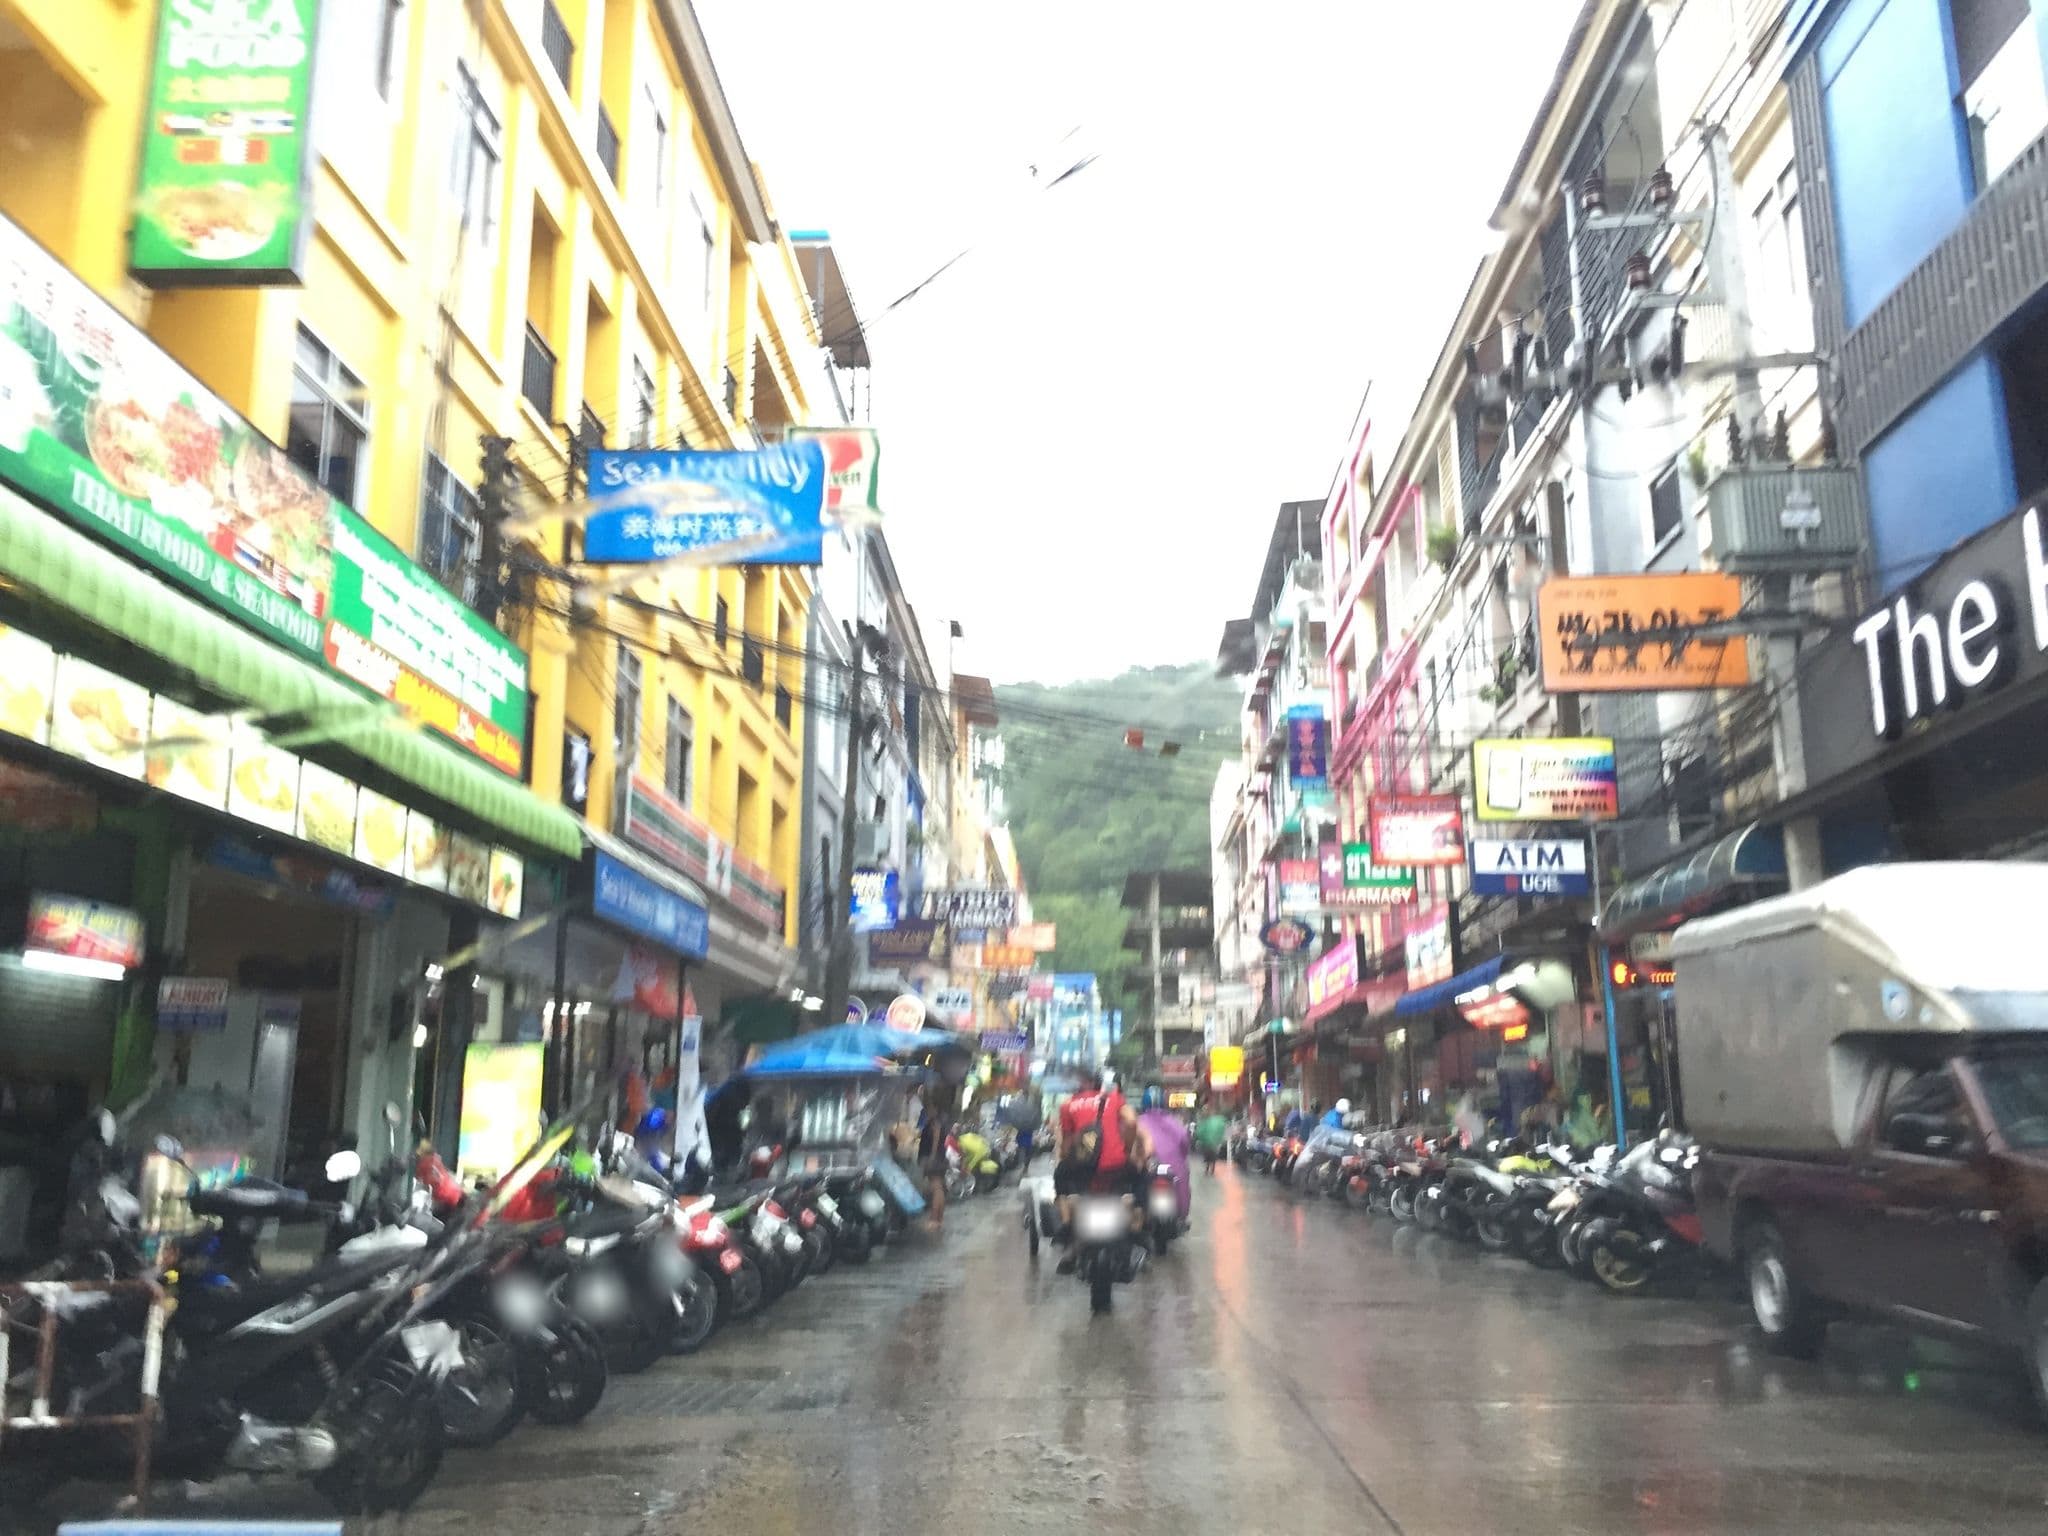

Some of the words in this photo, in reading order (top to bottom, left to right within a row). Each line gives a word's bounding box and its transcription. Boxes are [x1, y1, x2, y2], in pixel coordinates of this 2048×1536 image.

[140, 510, 212, 582] FOOD
[233, 570, 322, 651] SEAFOOD
[1853, 579, 1999, 736] The
[1496, 844, 1565, 868] ATM
[1521, 873, 1563, 893] UOB
[1325, 887, 1412, 905] PHARMACY
